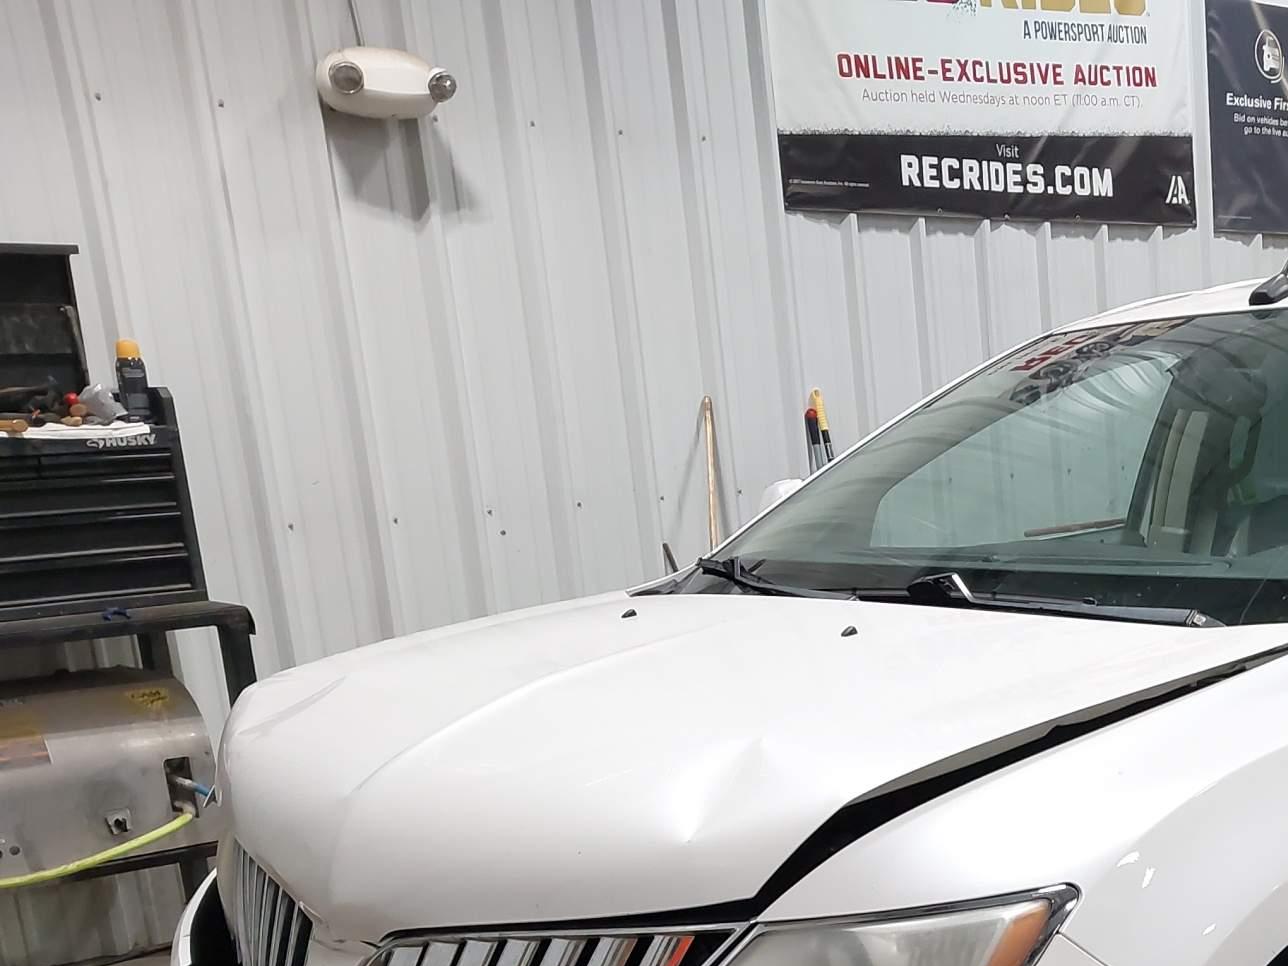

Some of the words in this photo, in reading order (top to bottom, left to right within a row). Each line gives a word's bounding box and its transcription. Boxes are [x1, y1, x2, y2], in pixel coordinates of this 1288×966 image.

[1022, 19, 1032, 40] A
[1034, 20, 1105, 42] POWERSPORT
[1107, 23, 1148, 45] AUCTION
[837, 53, 1064, 87] ONLINE-EXCLUSIVE
[1074, 64, 1157, 88] AUCTION
[862, 88, 908, 103] Auction
[910, 90, 936, 104] held
[939, 91, 1006, 107] Wednesdays
[1009, 95, 1020, 106] at
[1023, 96, 1051, 106] noon
[1054, 94, 1068, 106] ET
[1226, 92, 1272, 109] Exclusive
[1234, 113, 1245, 122] Bid
[1247, 115, 1255, 123] on
[1244, 126, 1252, 135] go
[1254, 126, 1261, 134] to
[996, 144, 1019, 159] Visit
[900, 154, 1114, 197] RECRIDES.COM
[105, 433, 156, 448] HUSKY
